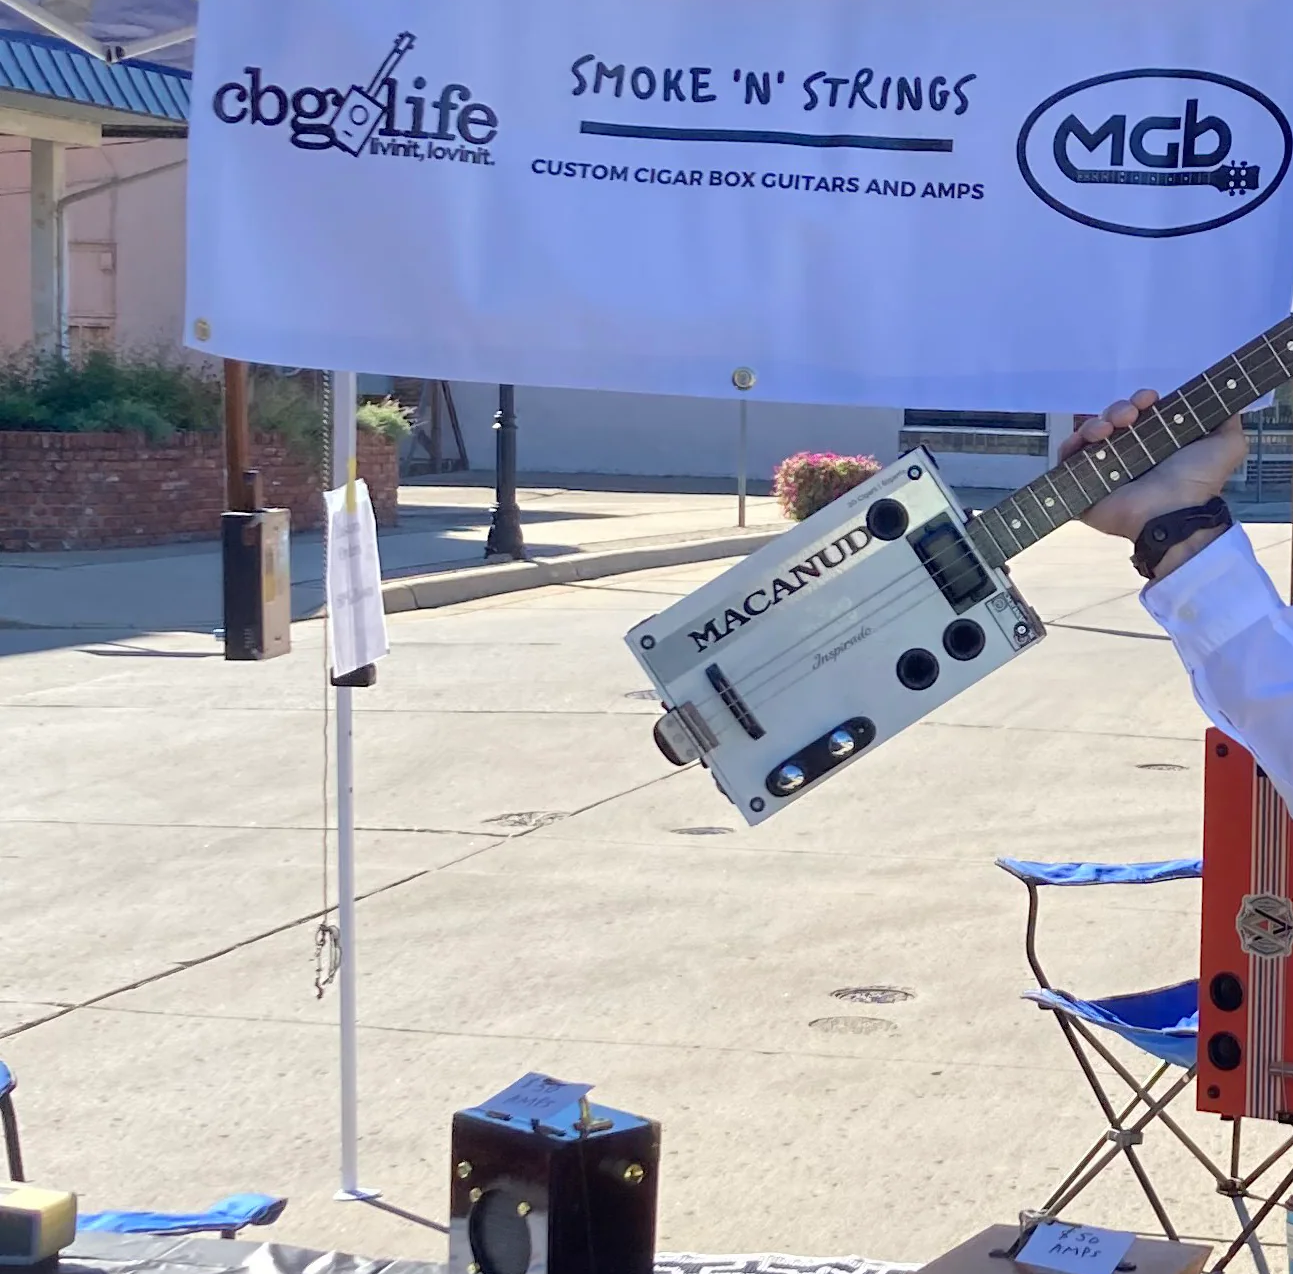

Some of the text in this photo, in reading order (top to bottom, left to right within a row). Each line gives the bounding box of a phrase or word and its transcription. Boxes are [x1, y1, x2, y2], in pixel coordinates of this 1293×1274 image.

[571, 54, 717, 103] SMOKE
[803, 67, 977, 116] STRINGS
[378, 76, 498, 145] life
[531, 159, 985, 200] CUSTOM CIGAR BOX GUITARS AND AMPS
[812, 626, 877, 671] Inspirado
[1048, 1243, 1102, 1258] AMPS
[1060, 1227, 1100, 1244] $50
